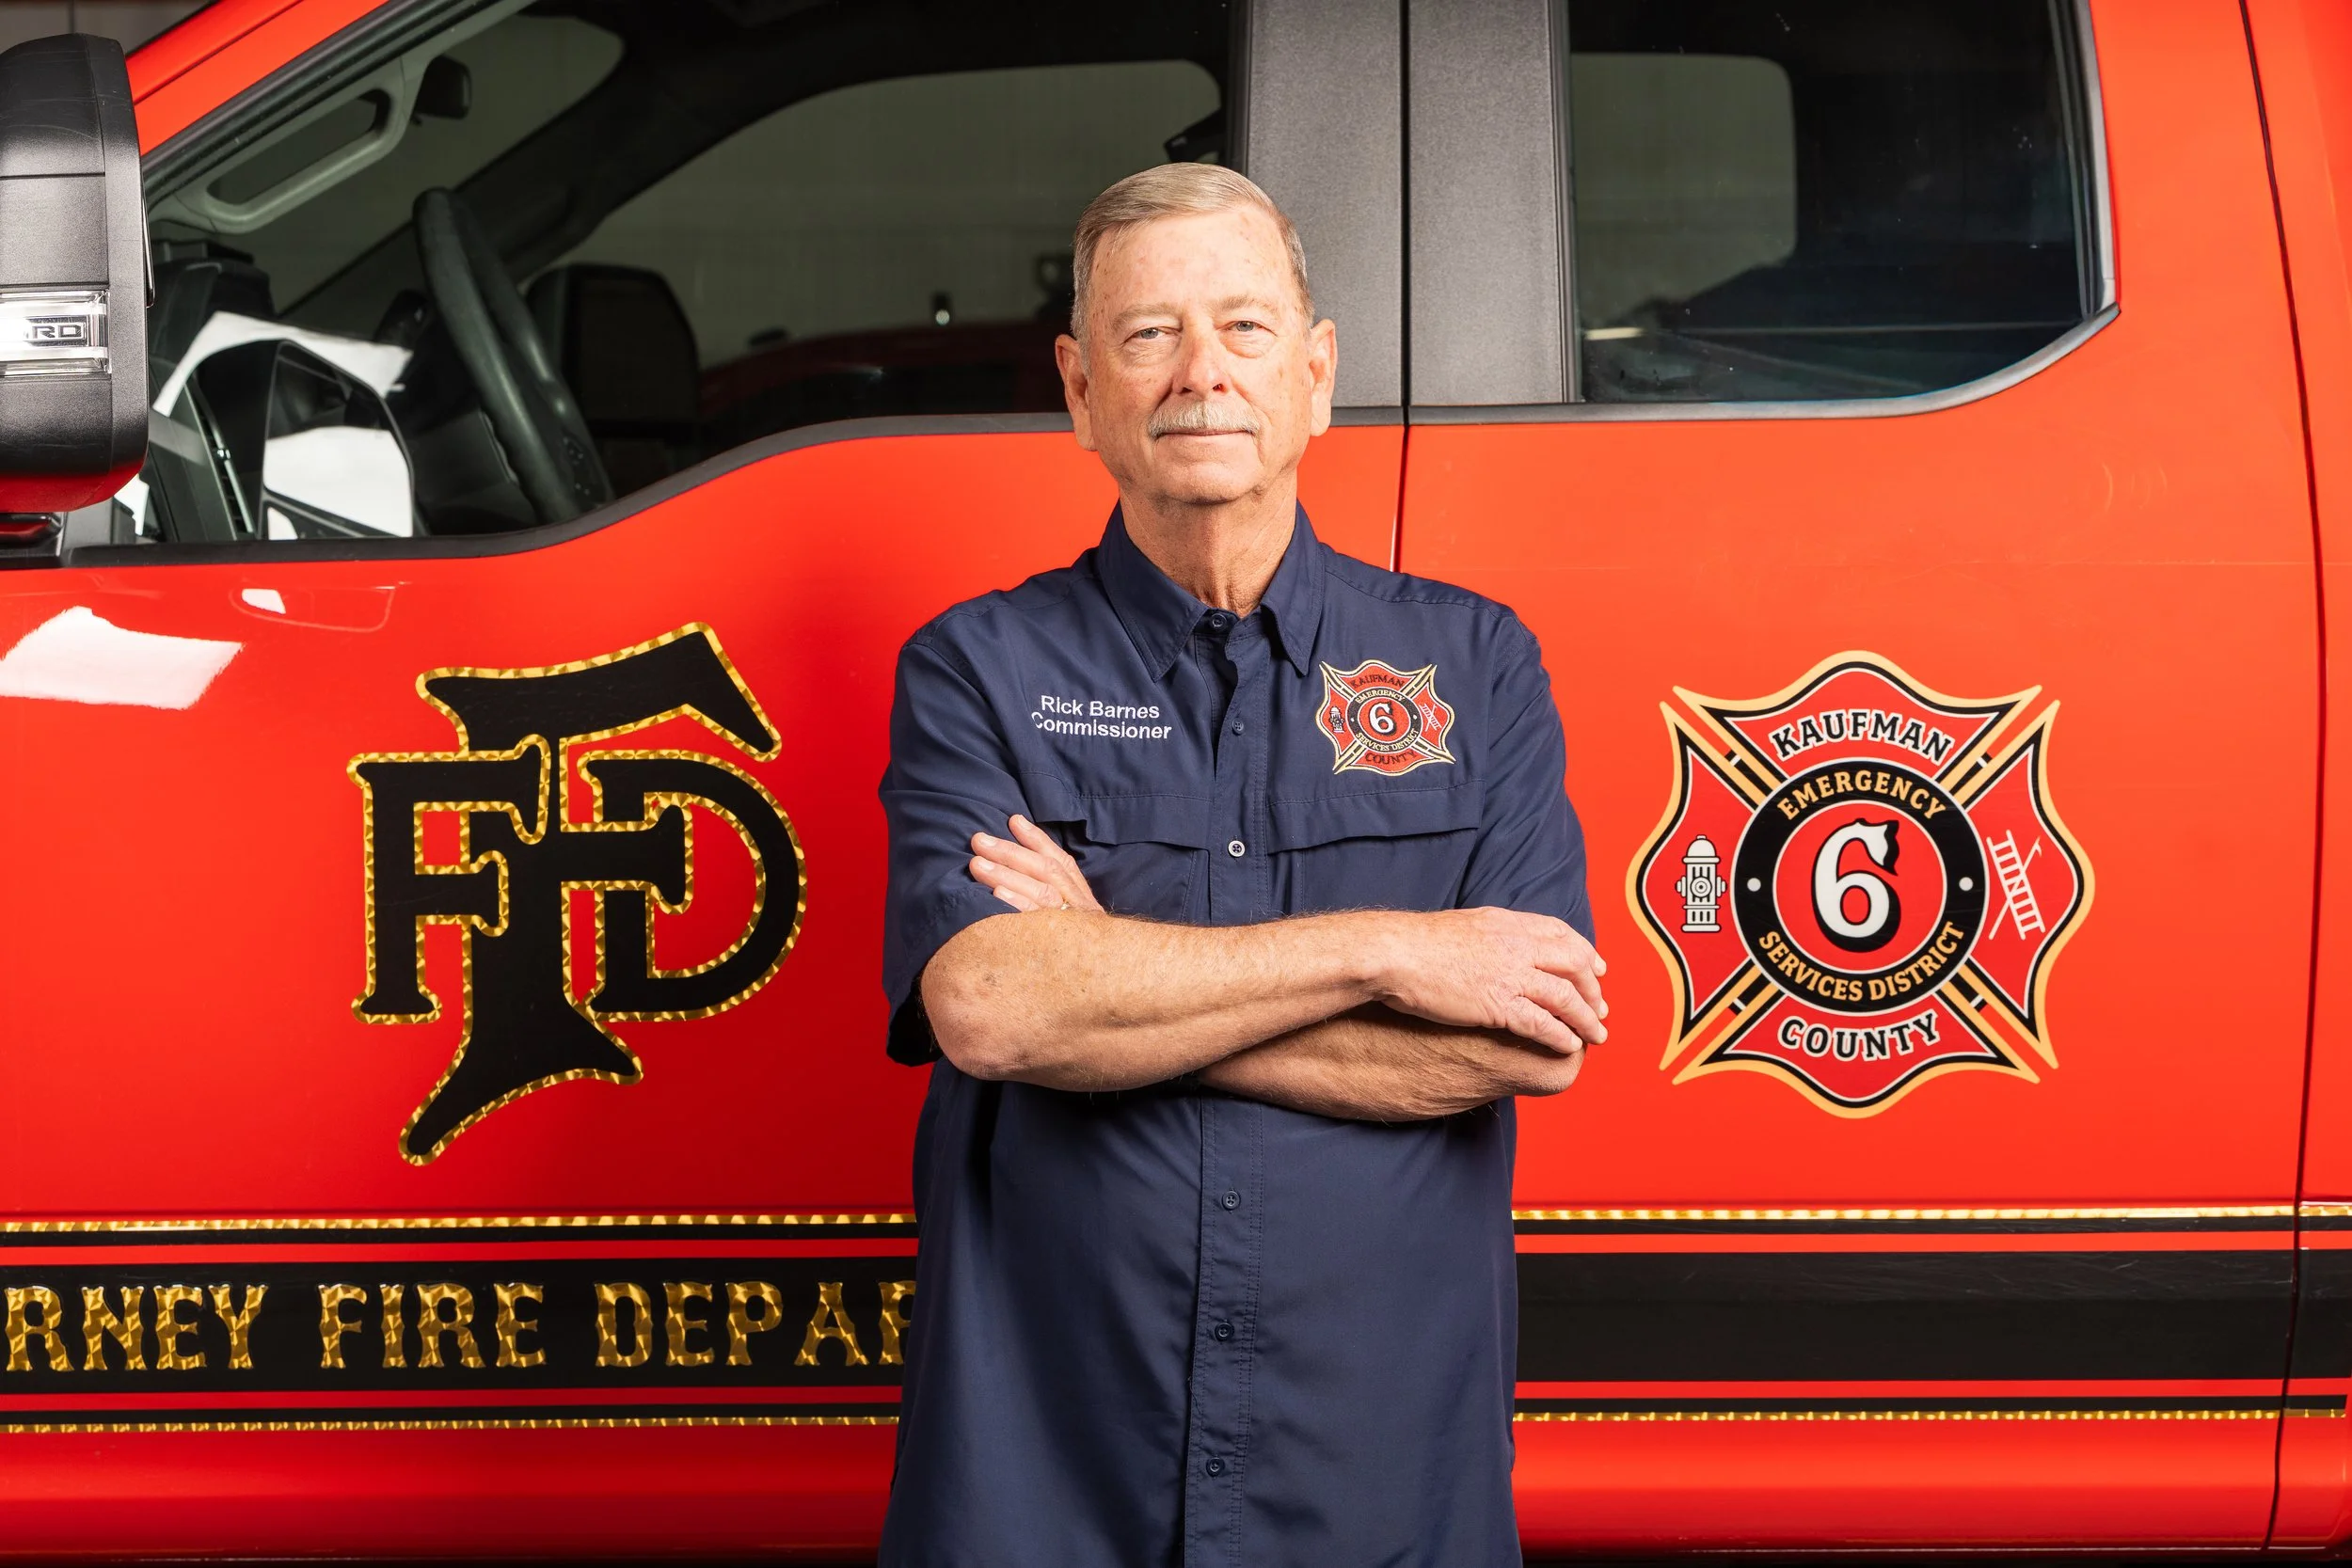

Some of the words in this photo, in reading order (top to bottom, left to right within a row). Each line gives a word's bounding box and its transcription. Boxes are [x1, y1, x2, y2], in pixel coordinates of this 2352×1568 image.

[24, 325, 83, 340] RD
[1349, 673, 1406, 689] KAUFMAN
[1355, 689, 1406, 704] EMERGENCY
[1040, 694, 1085, 717] Rick
[1089, 700, 1160, 720] Barnes
[1369, 701, 1397, 736] 6
[1031, 711, 1172, 739] Commissioner
[1355, 732, 1391, 752] SERVICES
[1391, 728, 1420, 752] DISTRICT
[1771, 710, 1954, 765] KAUFMAN
[1365, 751, 1416, 765] COUNTY
[1777, 769, 1947, 821] EMERGENCY
[1811, 817, 1902, 953] 6
[1758, 929, 1864, 1002] SERVICES
[1867, 921, 1965, 1002] DISTRICT
[1778, 1013, 1940, 1061] COUNTY
[5, 1284, 269, 1372] RNEY
[318, 1282, 547, 1370] FIRE
